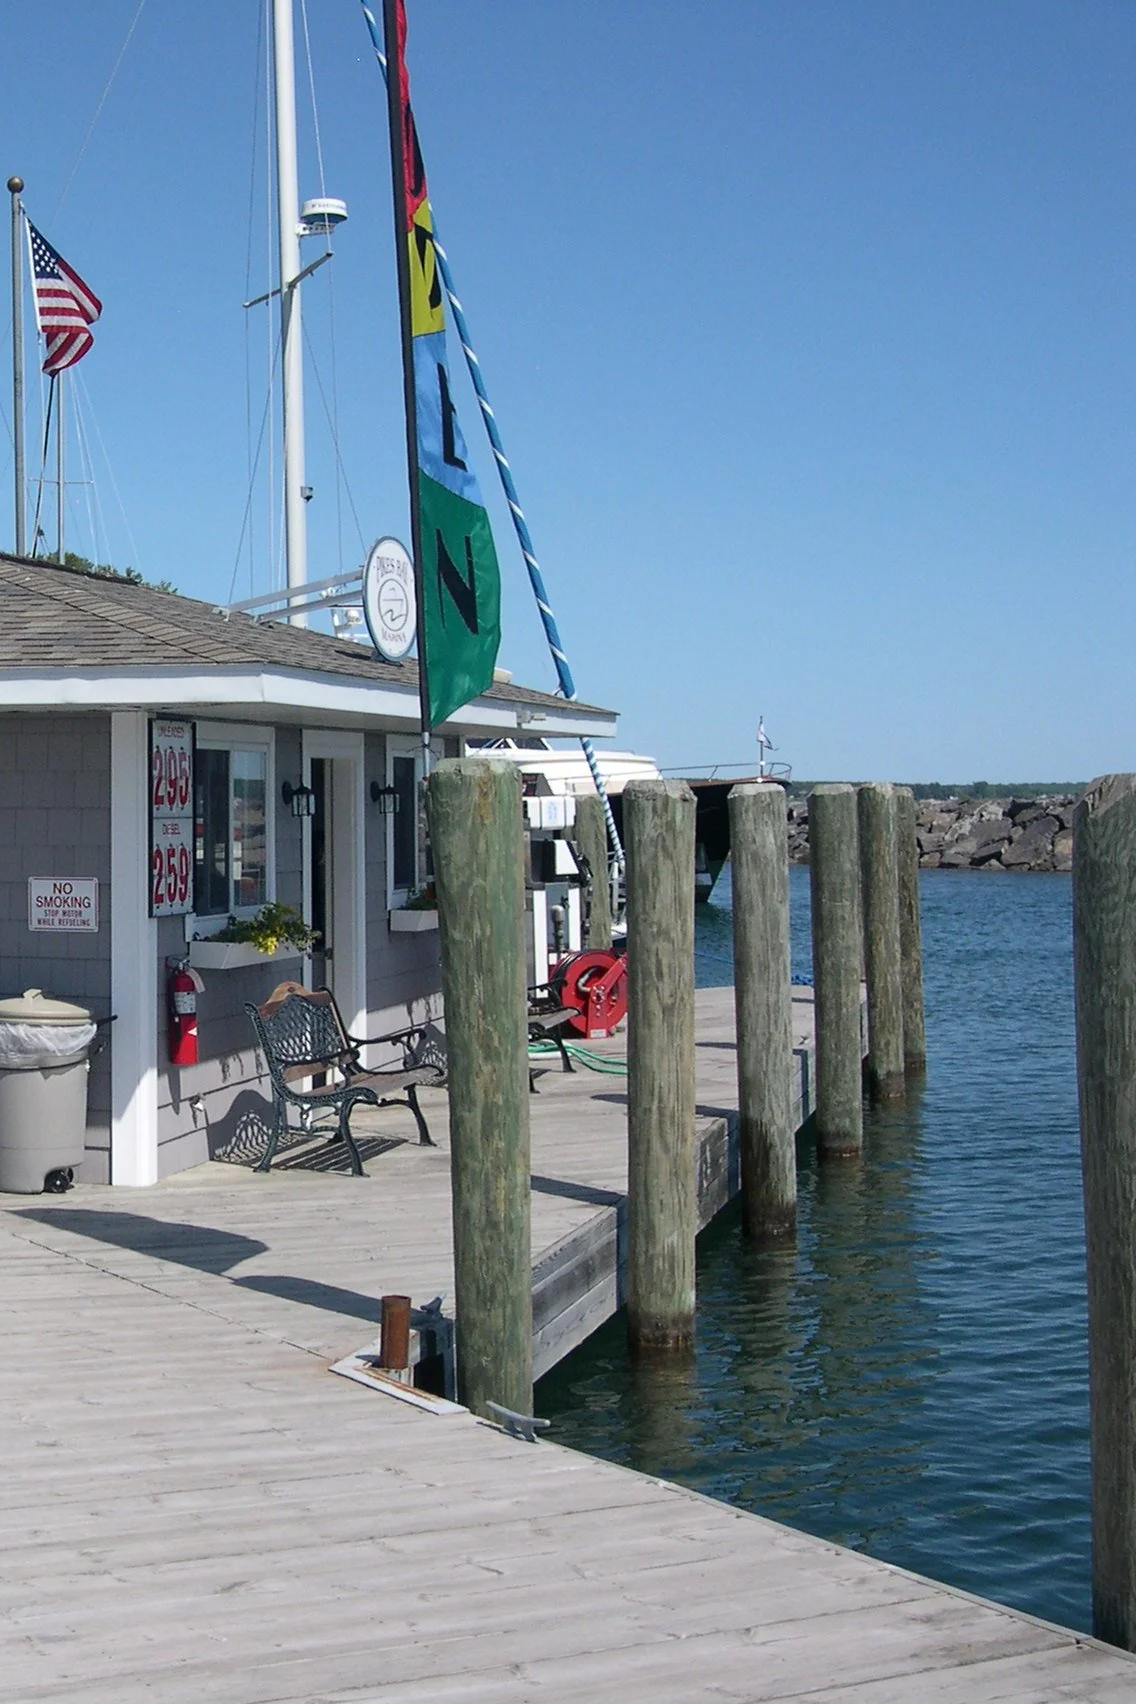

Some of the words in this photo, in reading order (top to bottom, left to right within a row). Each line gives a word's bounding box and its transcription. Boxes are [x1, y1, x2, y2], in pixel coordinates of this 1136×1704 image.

[152, 848, 189, 904] 259
[53, 883, 73, 894] NO
[36, 896, 91, 908] SMOKING
[37, 918, 55, 926] WHILE
[58, 919, 90, 927] REFUELING
